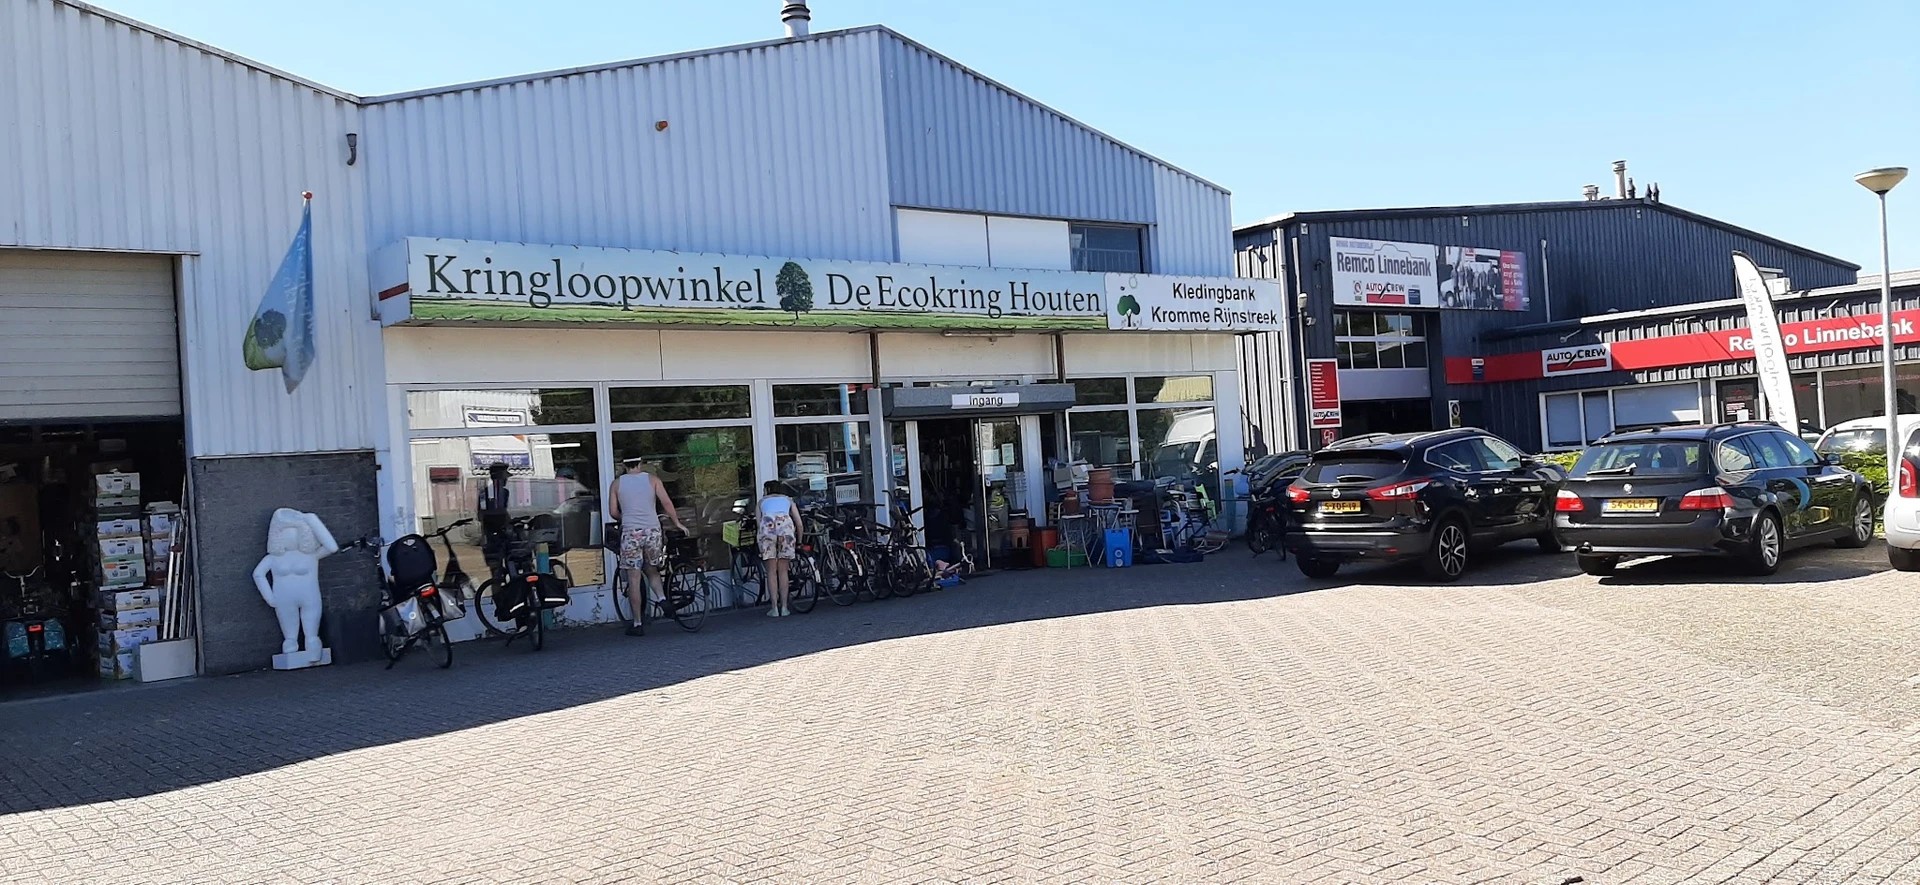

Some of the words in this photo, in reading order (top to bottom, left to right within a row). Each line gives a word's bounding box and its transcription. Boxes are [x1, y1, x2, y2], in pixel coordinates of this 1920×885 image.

[1336, 251, 1375, 274] Remco
[1377, 254, 1432, 277] Linnebank
[425, 254, 765, 311] Kringloopwinkel
[1172, 282, 1256, 304] Kledingbank
[826, 273, 872, 306] De
[876, 275, 1001, 319] Ecokring
[1009, 281, 1101, 313] Houten
[1151, 306, 1211, 323] Kromme
[1214, 307, 1278, 327] Rijnstreek
[1729, 333, 1797, 352] Reo
[1546, 351, 1571, 362] AUTO
[1577, 348, 1607, 359] CREW
[969, 395, 1003, 407] Ingang
